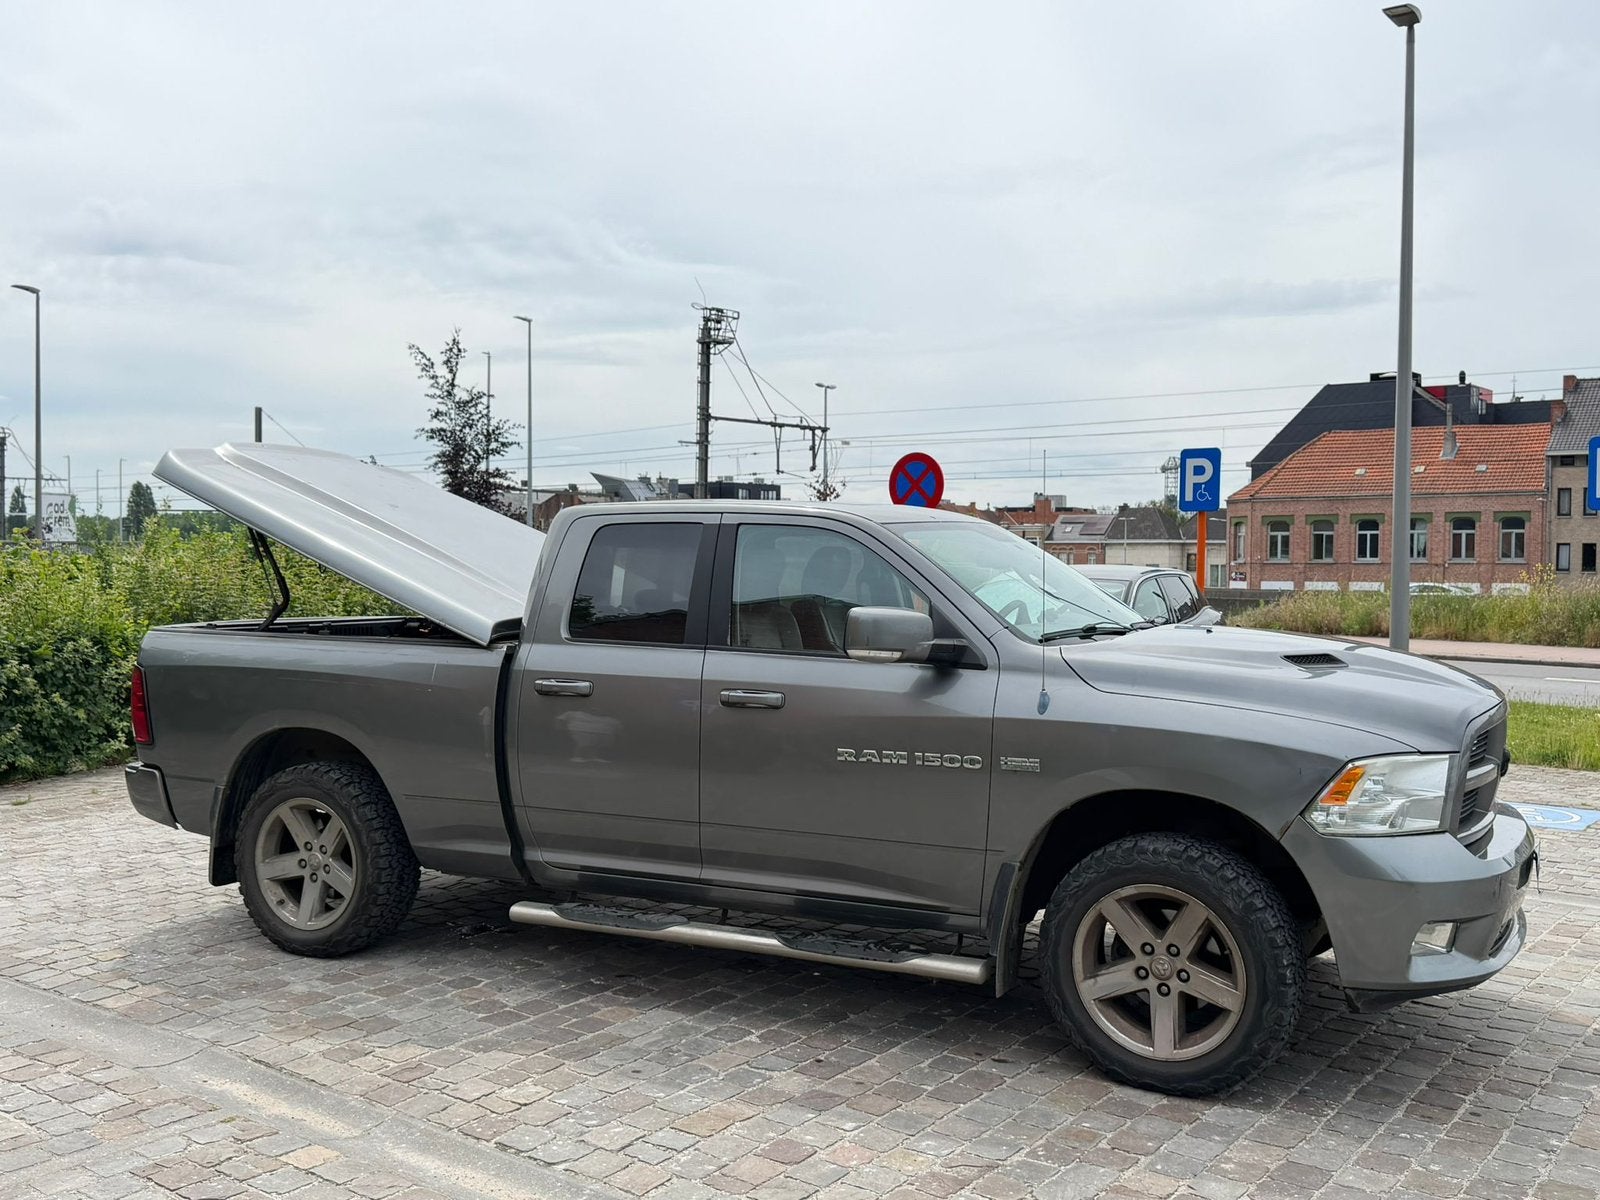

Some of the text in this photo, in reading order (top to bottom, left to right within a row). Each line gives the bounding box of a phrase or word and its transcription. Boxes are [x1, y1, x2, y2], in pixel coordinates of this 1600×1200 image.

[1185, 457, 1214, 502] P
[837, 748, 983, 769] RAM 1500
